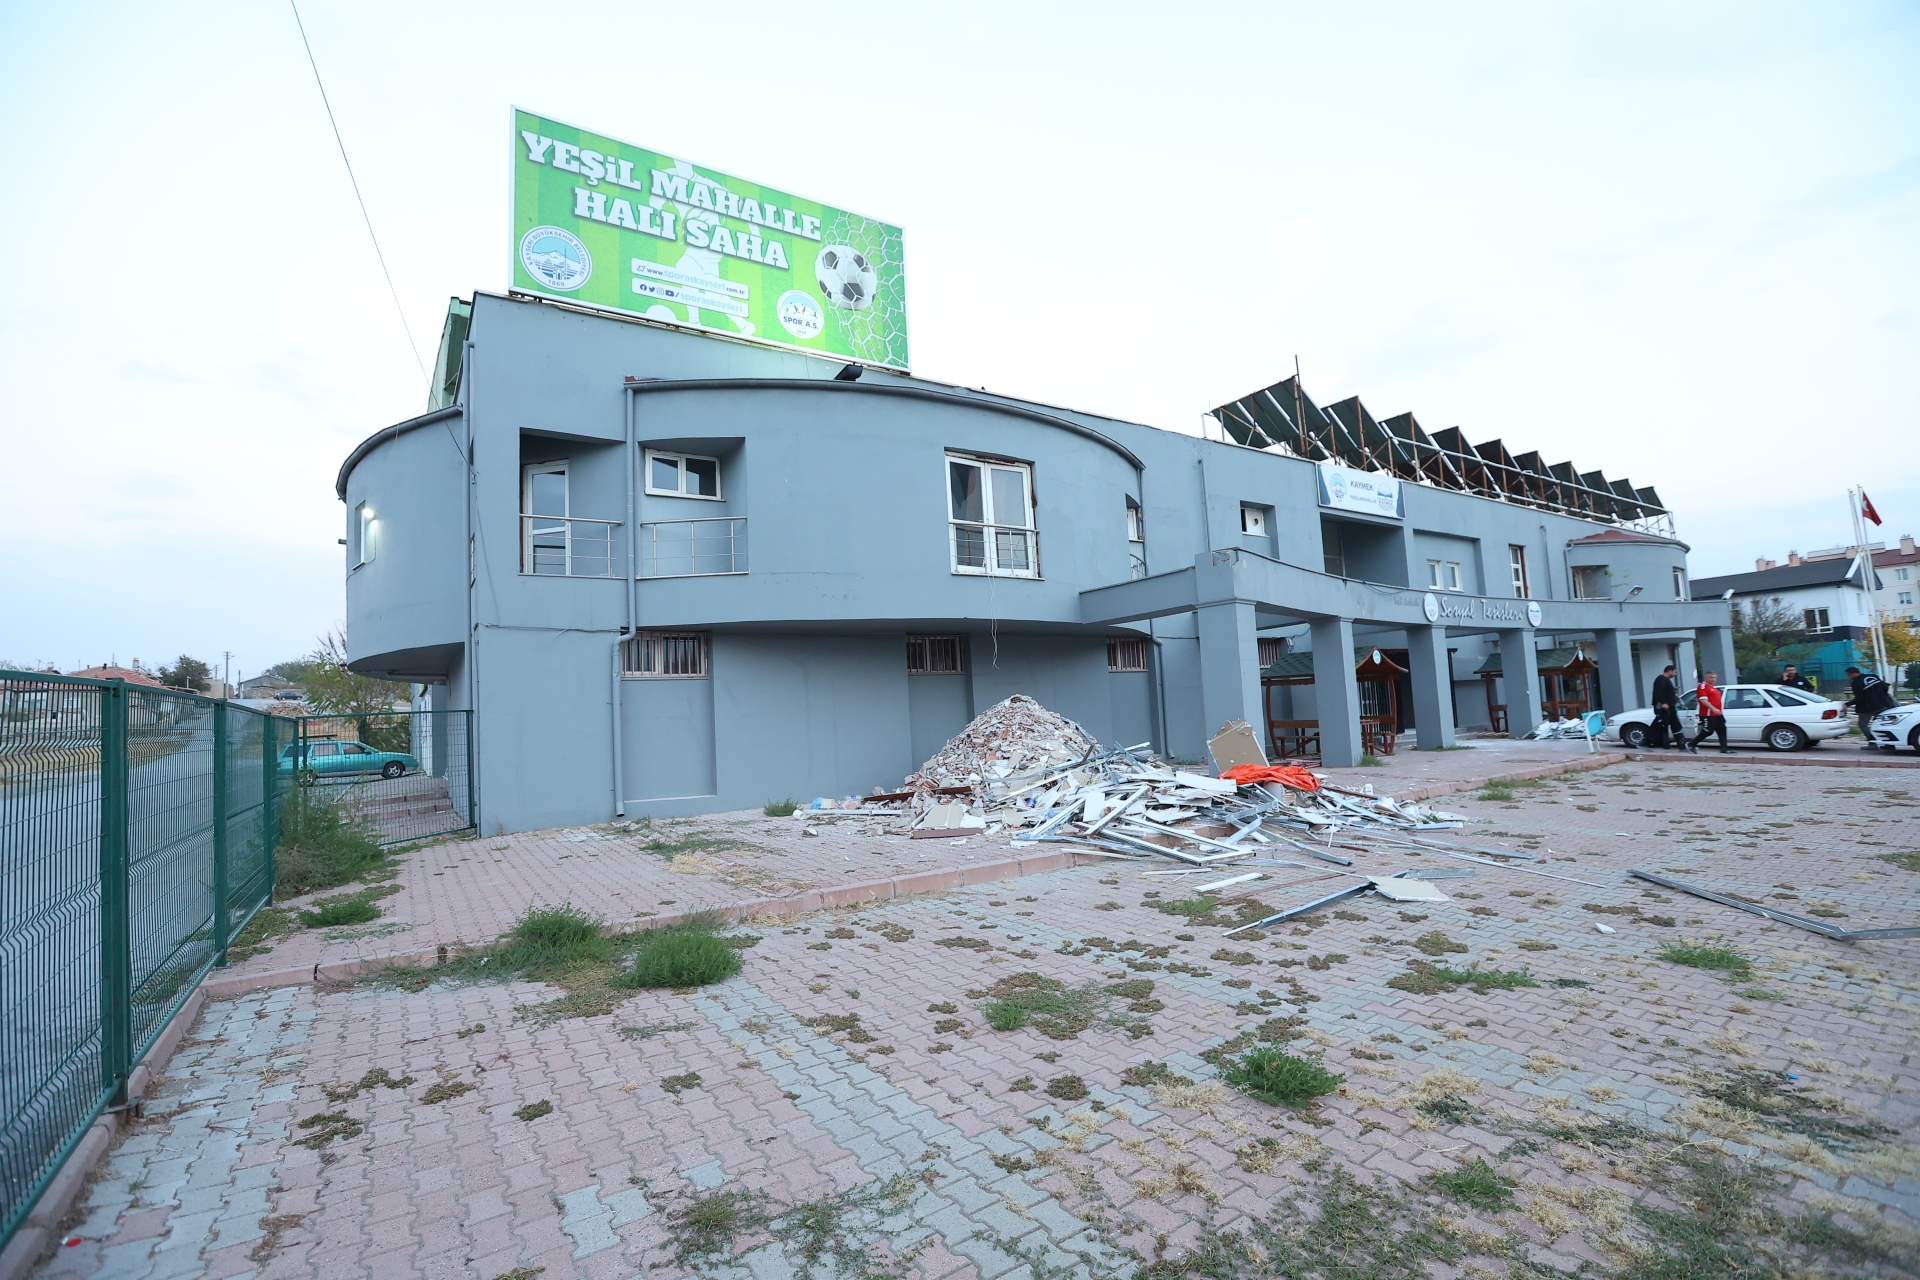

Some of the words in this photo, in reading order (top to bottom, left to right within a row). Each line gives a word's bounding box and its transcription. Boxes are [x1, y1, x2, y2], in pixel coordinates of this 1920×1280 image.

[650, 168, 822, 241] MAHALLE
[574, 187, 676, 241] HALI
[686, 218, 790, 270] SAHA
[646, 268, 745, 295] www.sporaskayseri.com.tr
[783, 315, 803, 326] SPOR
[1350, 480, 1374, 491] KAYMEK
[1440, 596, 1476, 626] Sosyal
[1480, 599, 1525, 621] Tesisleri
